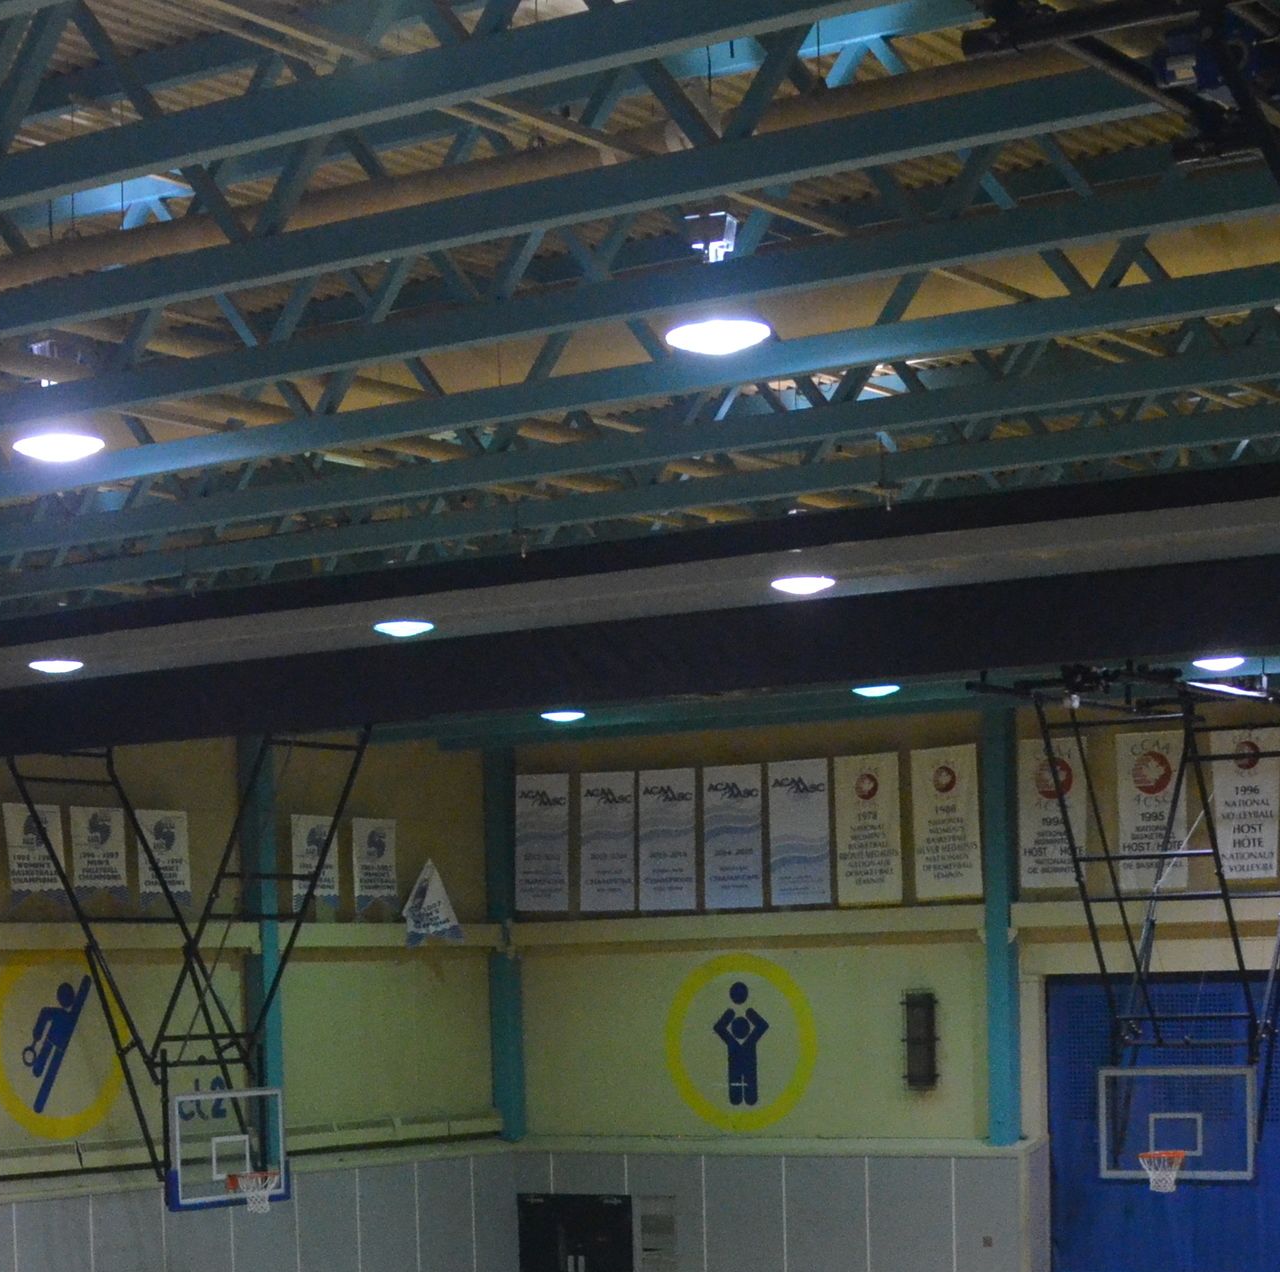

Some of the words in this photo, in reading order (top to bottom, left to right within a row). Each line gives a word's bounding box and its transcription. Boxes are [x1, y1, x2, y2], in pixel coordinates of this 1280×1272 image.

[1235, 785, 1260, 795] 1996
[1224, 800, 1270, 808] NATIONAL
[1232, 823, 1263, 834] HOST
[1123, 842, 1150, 853] HOST
